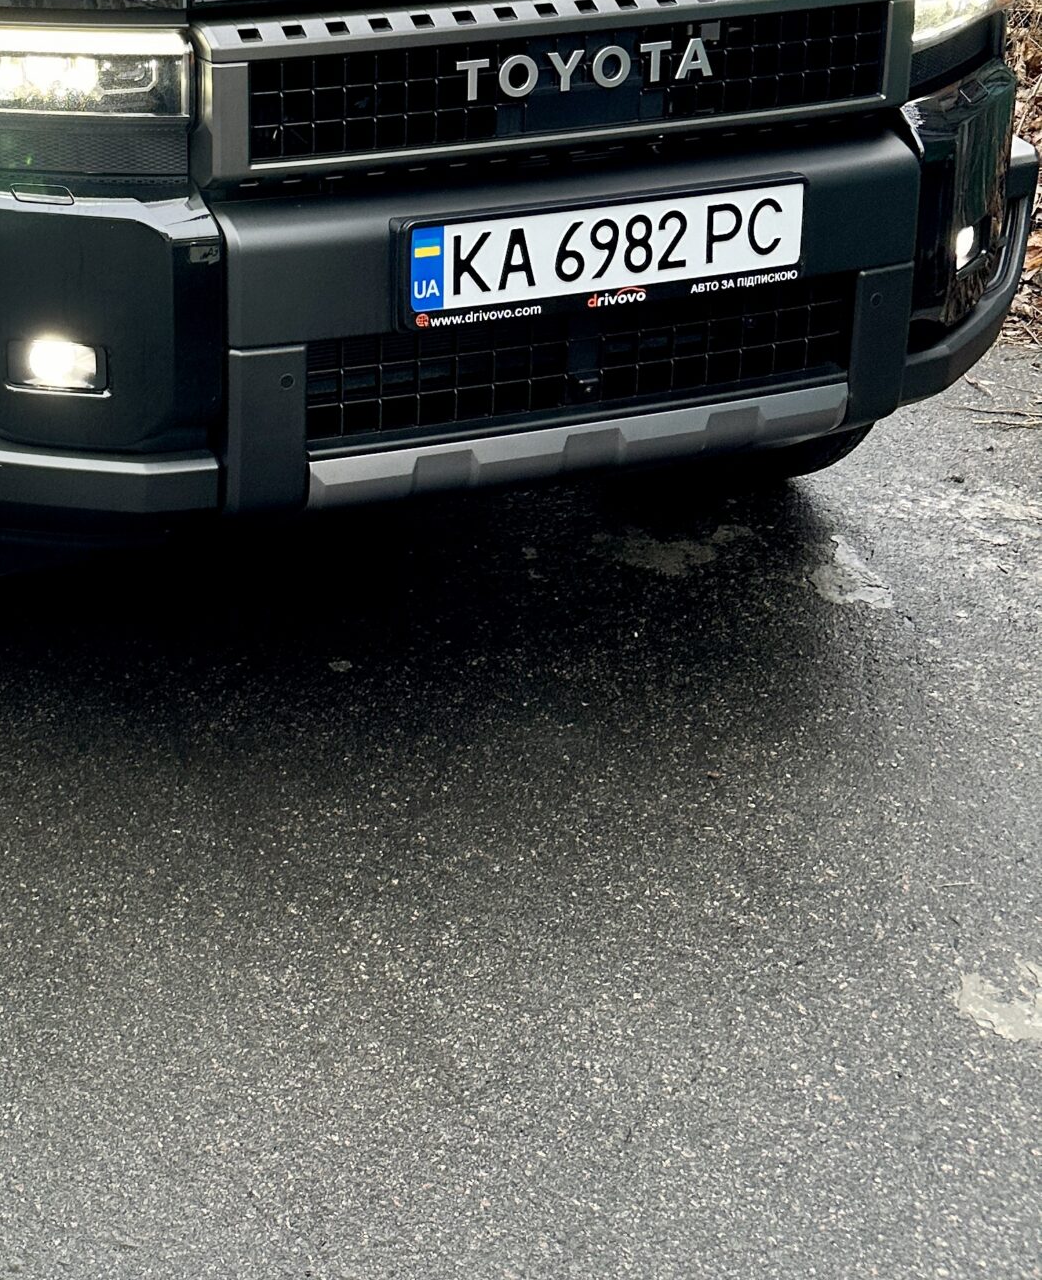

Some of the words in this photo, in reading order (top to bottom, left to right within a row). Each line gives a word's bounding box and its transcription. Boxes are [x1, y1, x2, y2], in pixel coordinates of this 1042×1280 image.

[455, 37, 713, 102] TOYOTA
[452, 227, 536, 296] KA
[554, 210, 688, 283] 6982
[705, 197, 783, 265] PC
[413, 279, 440, 299] UA
[690, 280, 719, 294] АВТО
[721, 278, 735, 290] ЗА
[737, 269, 798, 288] ПІДПИСКОЮ
[587, 288, 647, 308] drivovo
[430, 304, 542, 327] www.drivovo.com
